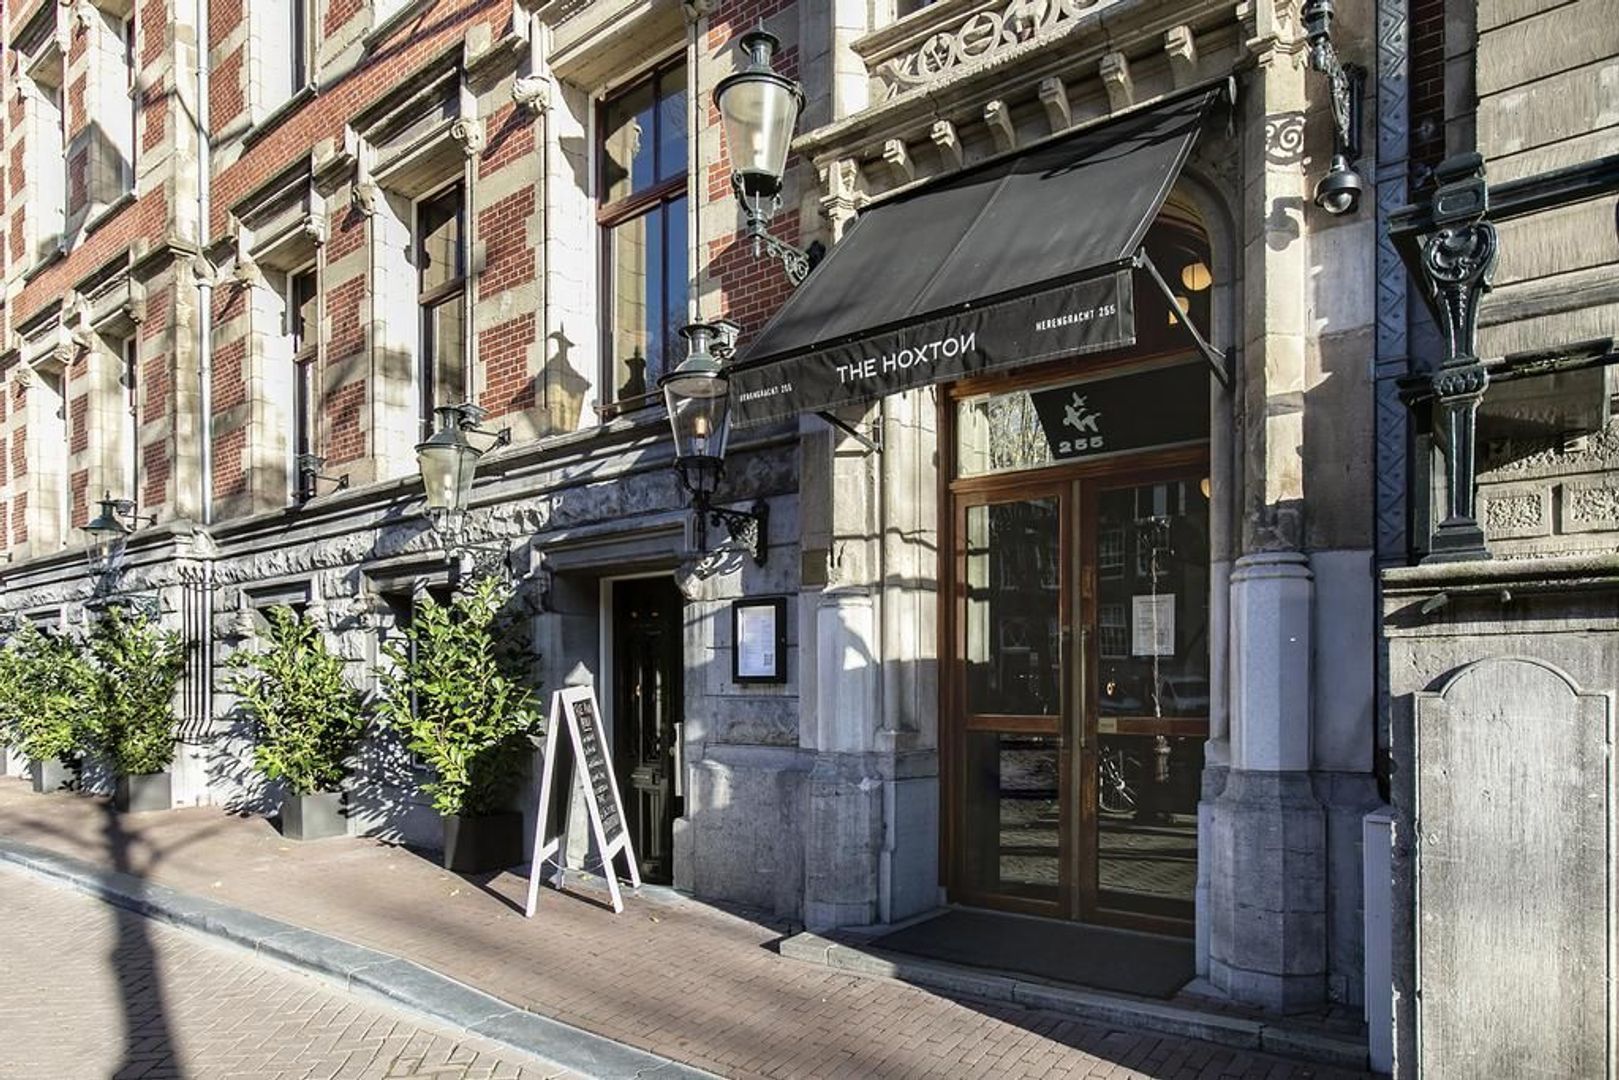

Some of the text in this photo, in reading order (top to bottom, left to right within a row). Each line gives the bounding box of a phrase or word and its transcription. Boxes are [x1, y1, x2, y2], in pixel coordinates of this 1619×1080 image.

[1035, 304, 1116, 331] HERENGRACHT 255
[836, 358, 877, 383] THE
[1059, 436, 1104, 453] 255
